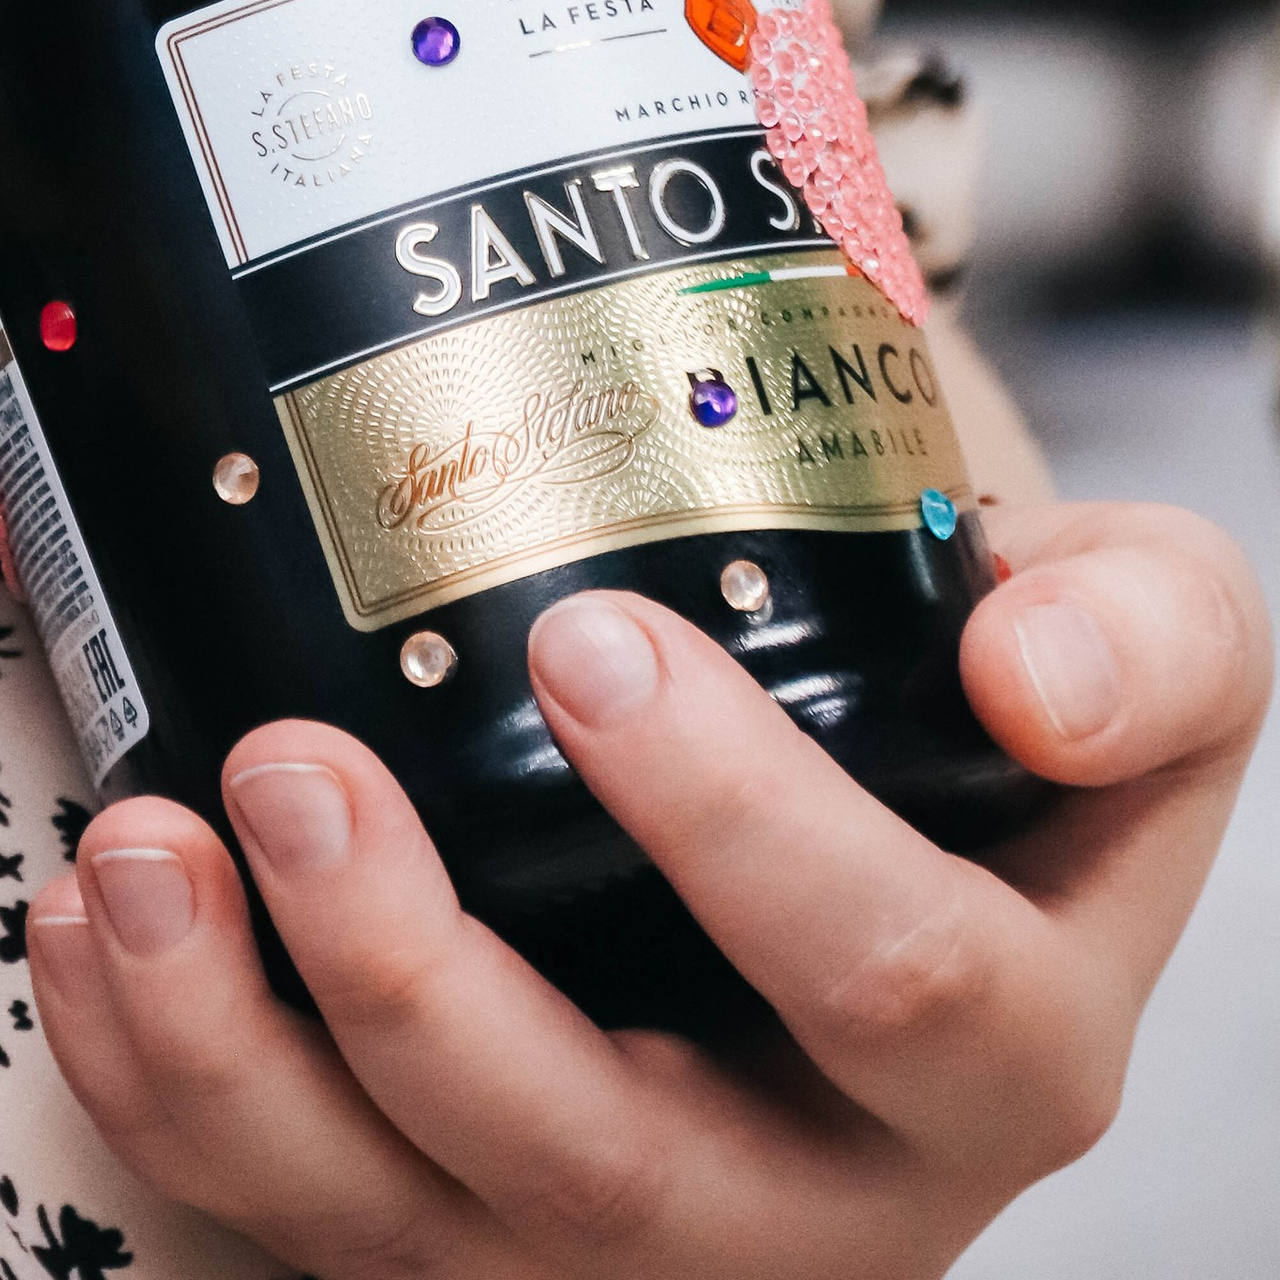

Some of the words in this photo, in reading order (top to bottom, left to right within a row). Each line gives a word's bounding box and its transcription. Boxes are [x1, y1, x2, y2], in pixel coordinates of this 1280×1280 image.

[519, 14, 557, 35] LA
[276, 63, 348, 87] FESTA
[251, 91, 273, 117] LA
[251, 92, 372, 158] S.STEFANO
[616, 91, 729, 123] MARCHIO
[270, 133, 373, 188] ITALIANA
[394, 157, 726, 317] SANTO
[376, 420, 491, 530] Santo
[492, 379, 640, 477] Stefano
